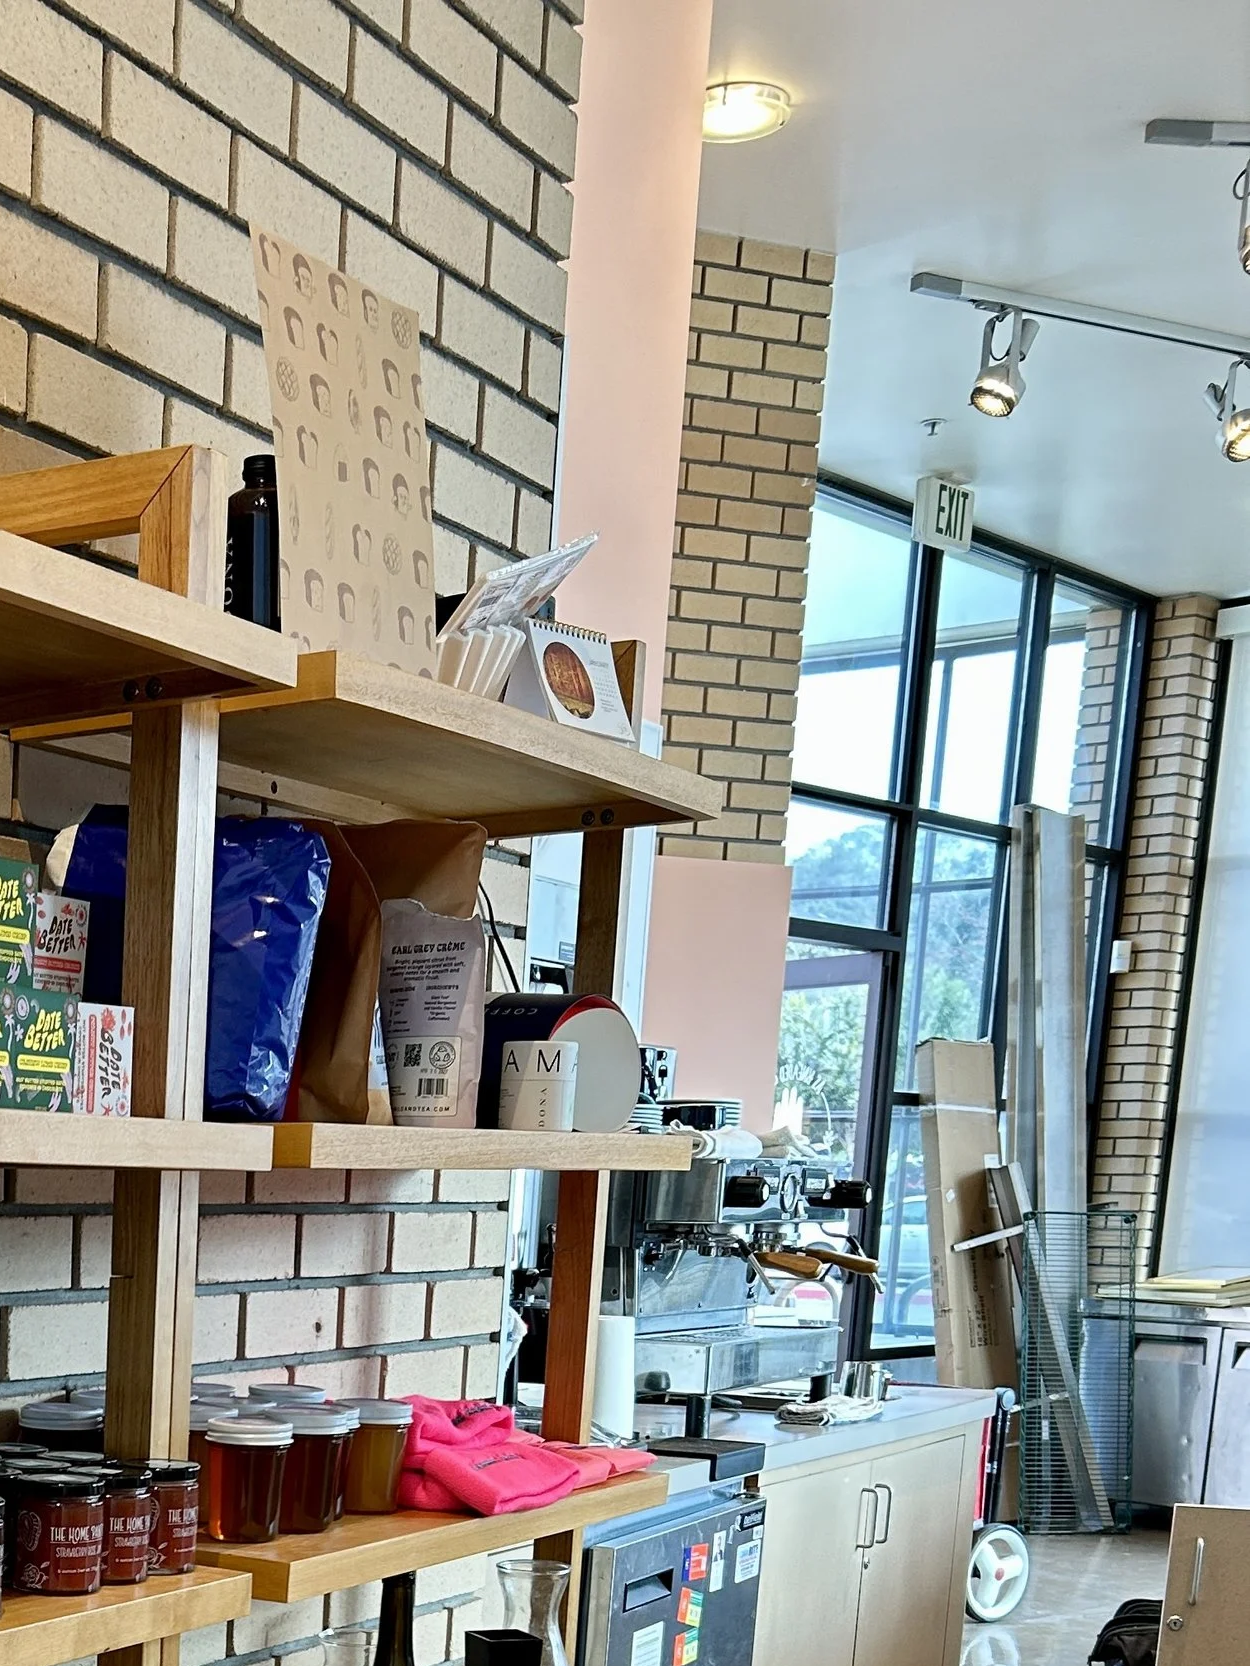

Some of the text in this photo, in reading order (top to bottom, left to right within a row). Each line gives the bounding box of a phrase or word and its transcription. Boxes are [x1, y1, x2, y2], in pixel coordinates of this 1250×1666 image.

[935, 483, 969, 541] EXIT
[50, 915, 73, 935] DATE
[38, 928, 76, 955] BETTER
[35, 1008, 62, 1033] DATE
[23, 1023, 66, 1053] BETTER
[98, 1027, 114, 1100] BETTER
[108, 1046, 123, 1091] DATE
[538, 1087, 548, 1128] DONA
[109, 1516, 145, 1533] THE HOME
[168, 1509, 182, 1523] THE
[50, 1526, 89, 1544] THE HOME
